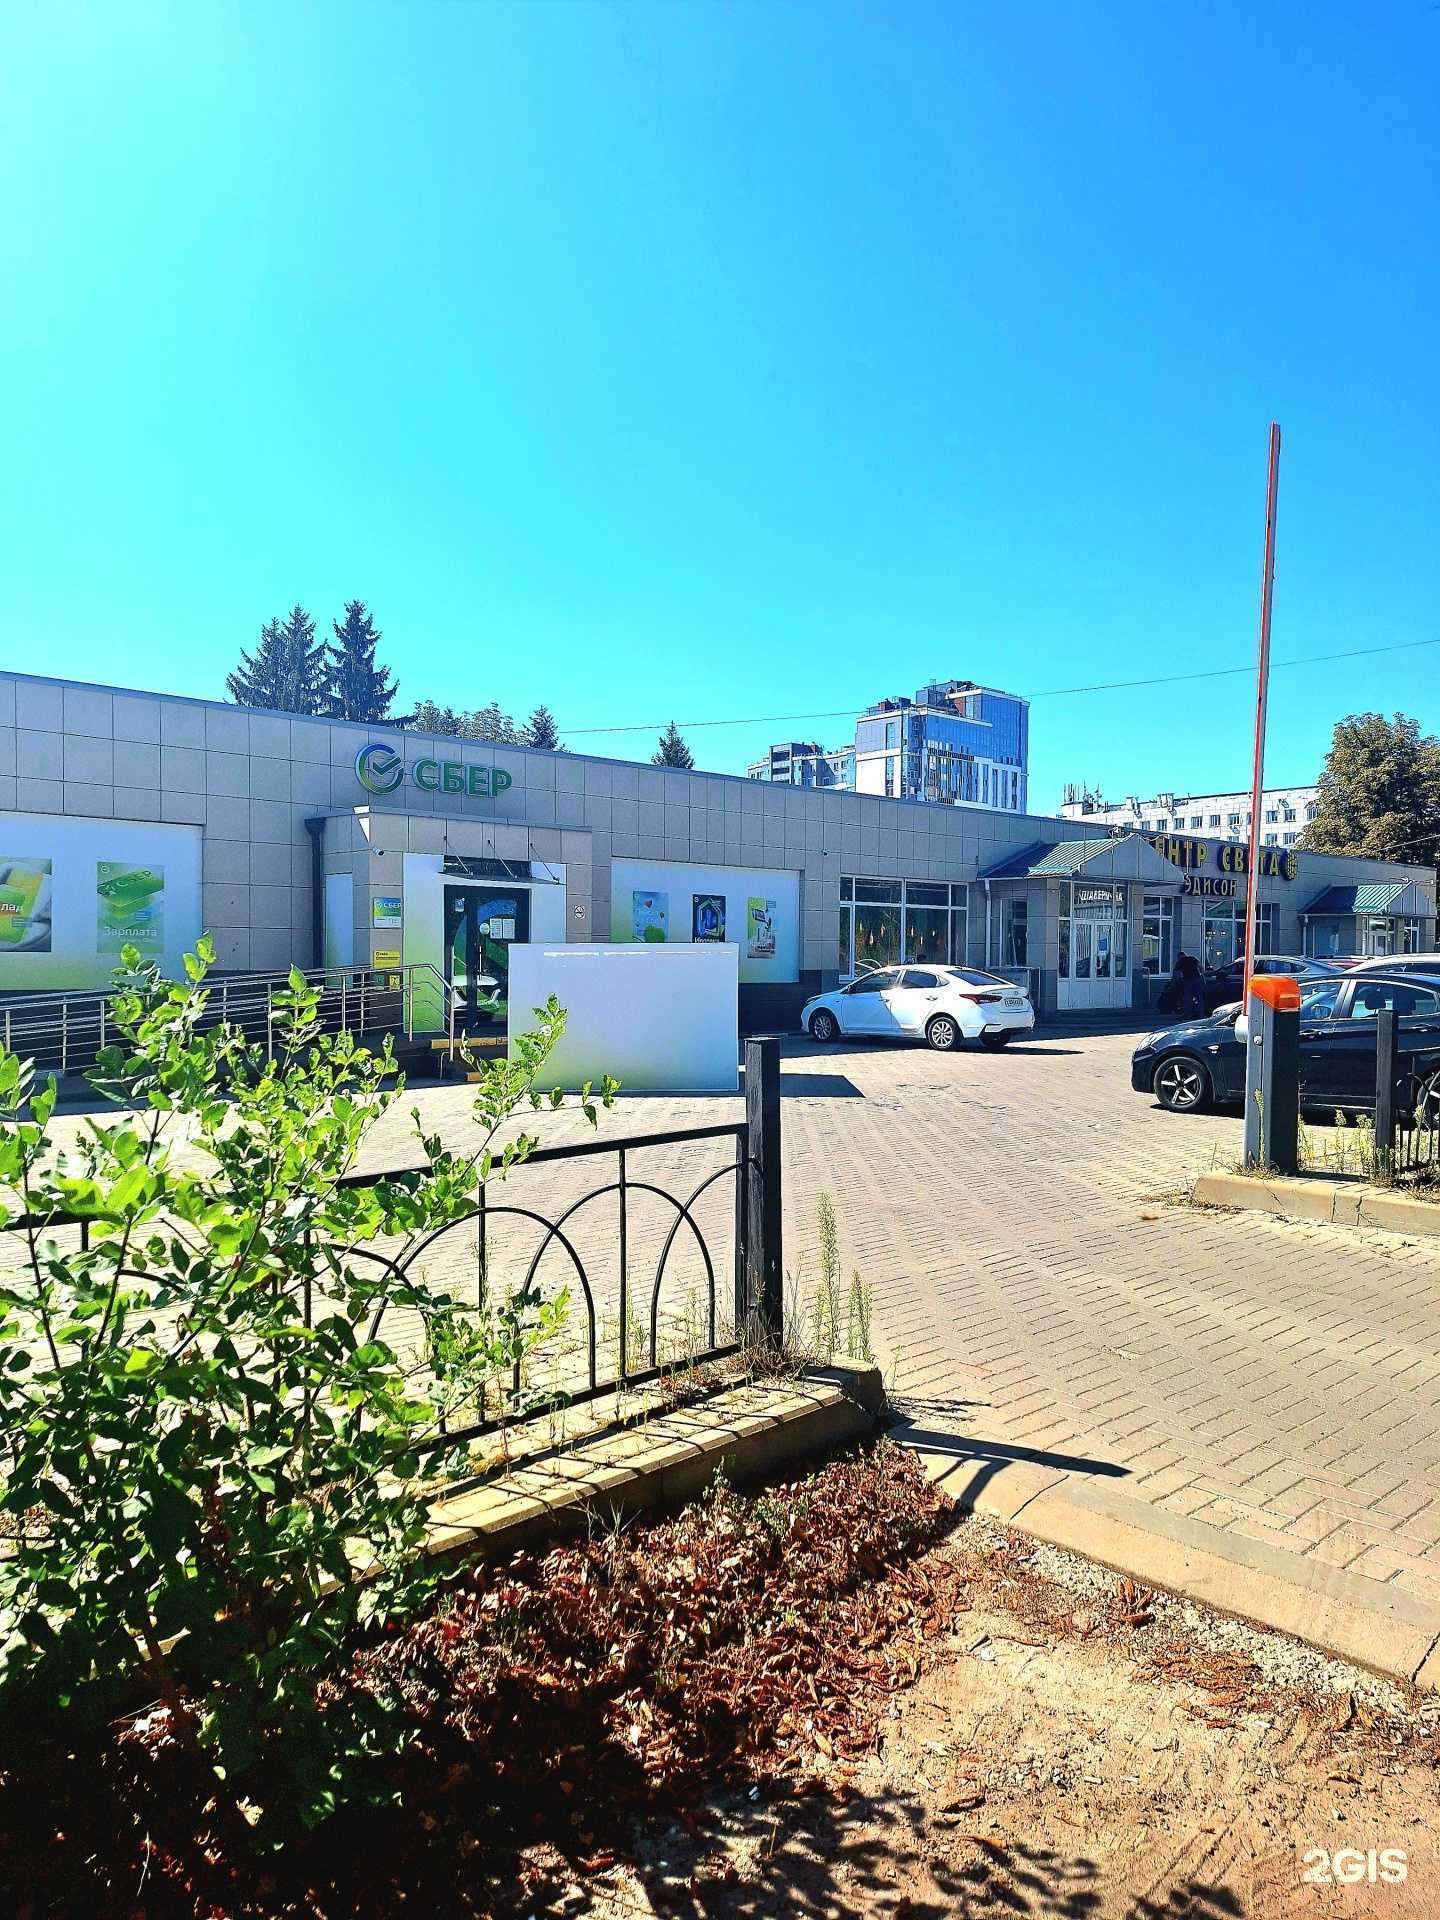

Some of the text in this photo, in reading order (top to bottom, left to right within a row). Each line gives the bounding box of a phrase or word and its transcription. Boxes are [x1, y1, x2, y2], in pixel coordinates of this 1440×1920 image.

[412, 757, 513, 798] СБЕР
[1154, 837, 1280, 876] ЕНТР СВТА
[1185, 875, 1238, 897] ЭДИСОН
[103, 926, 158, 938] Зарплата
